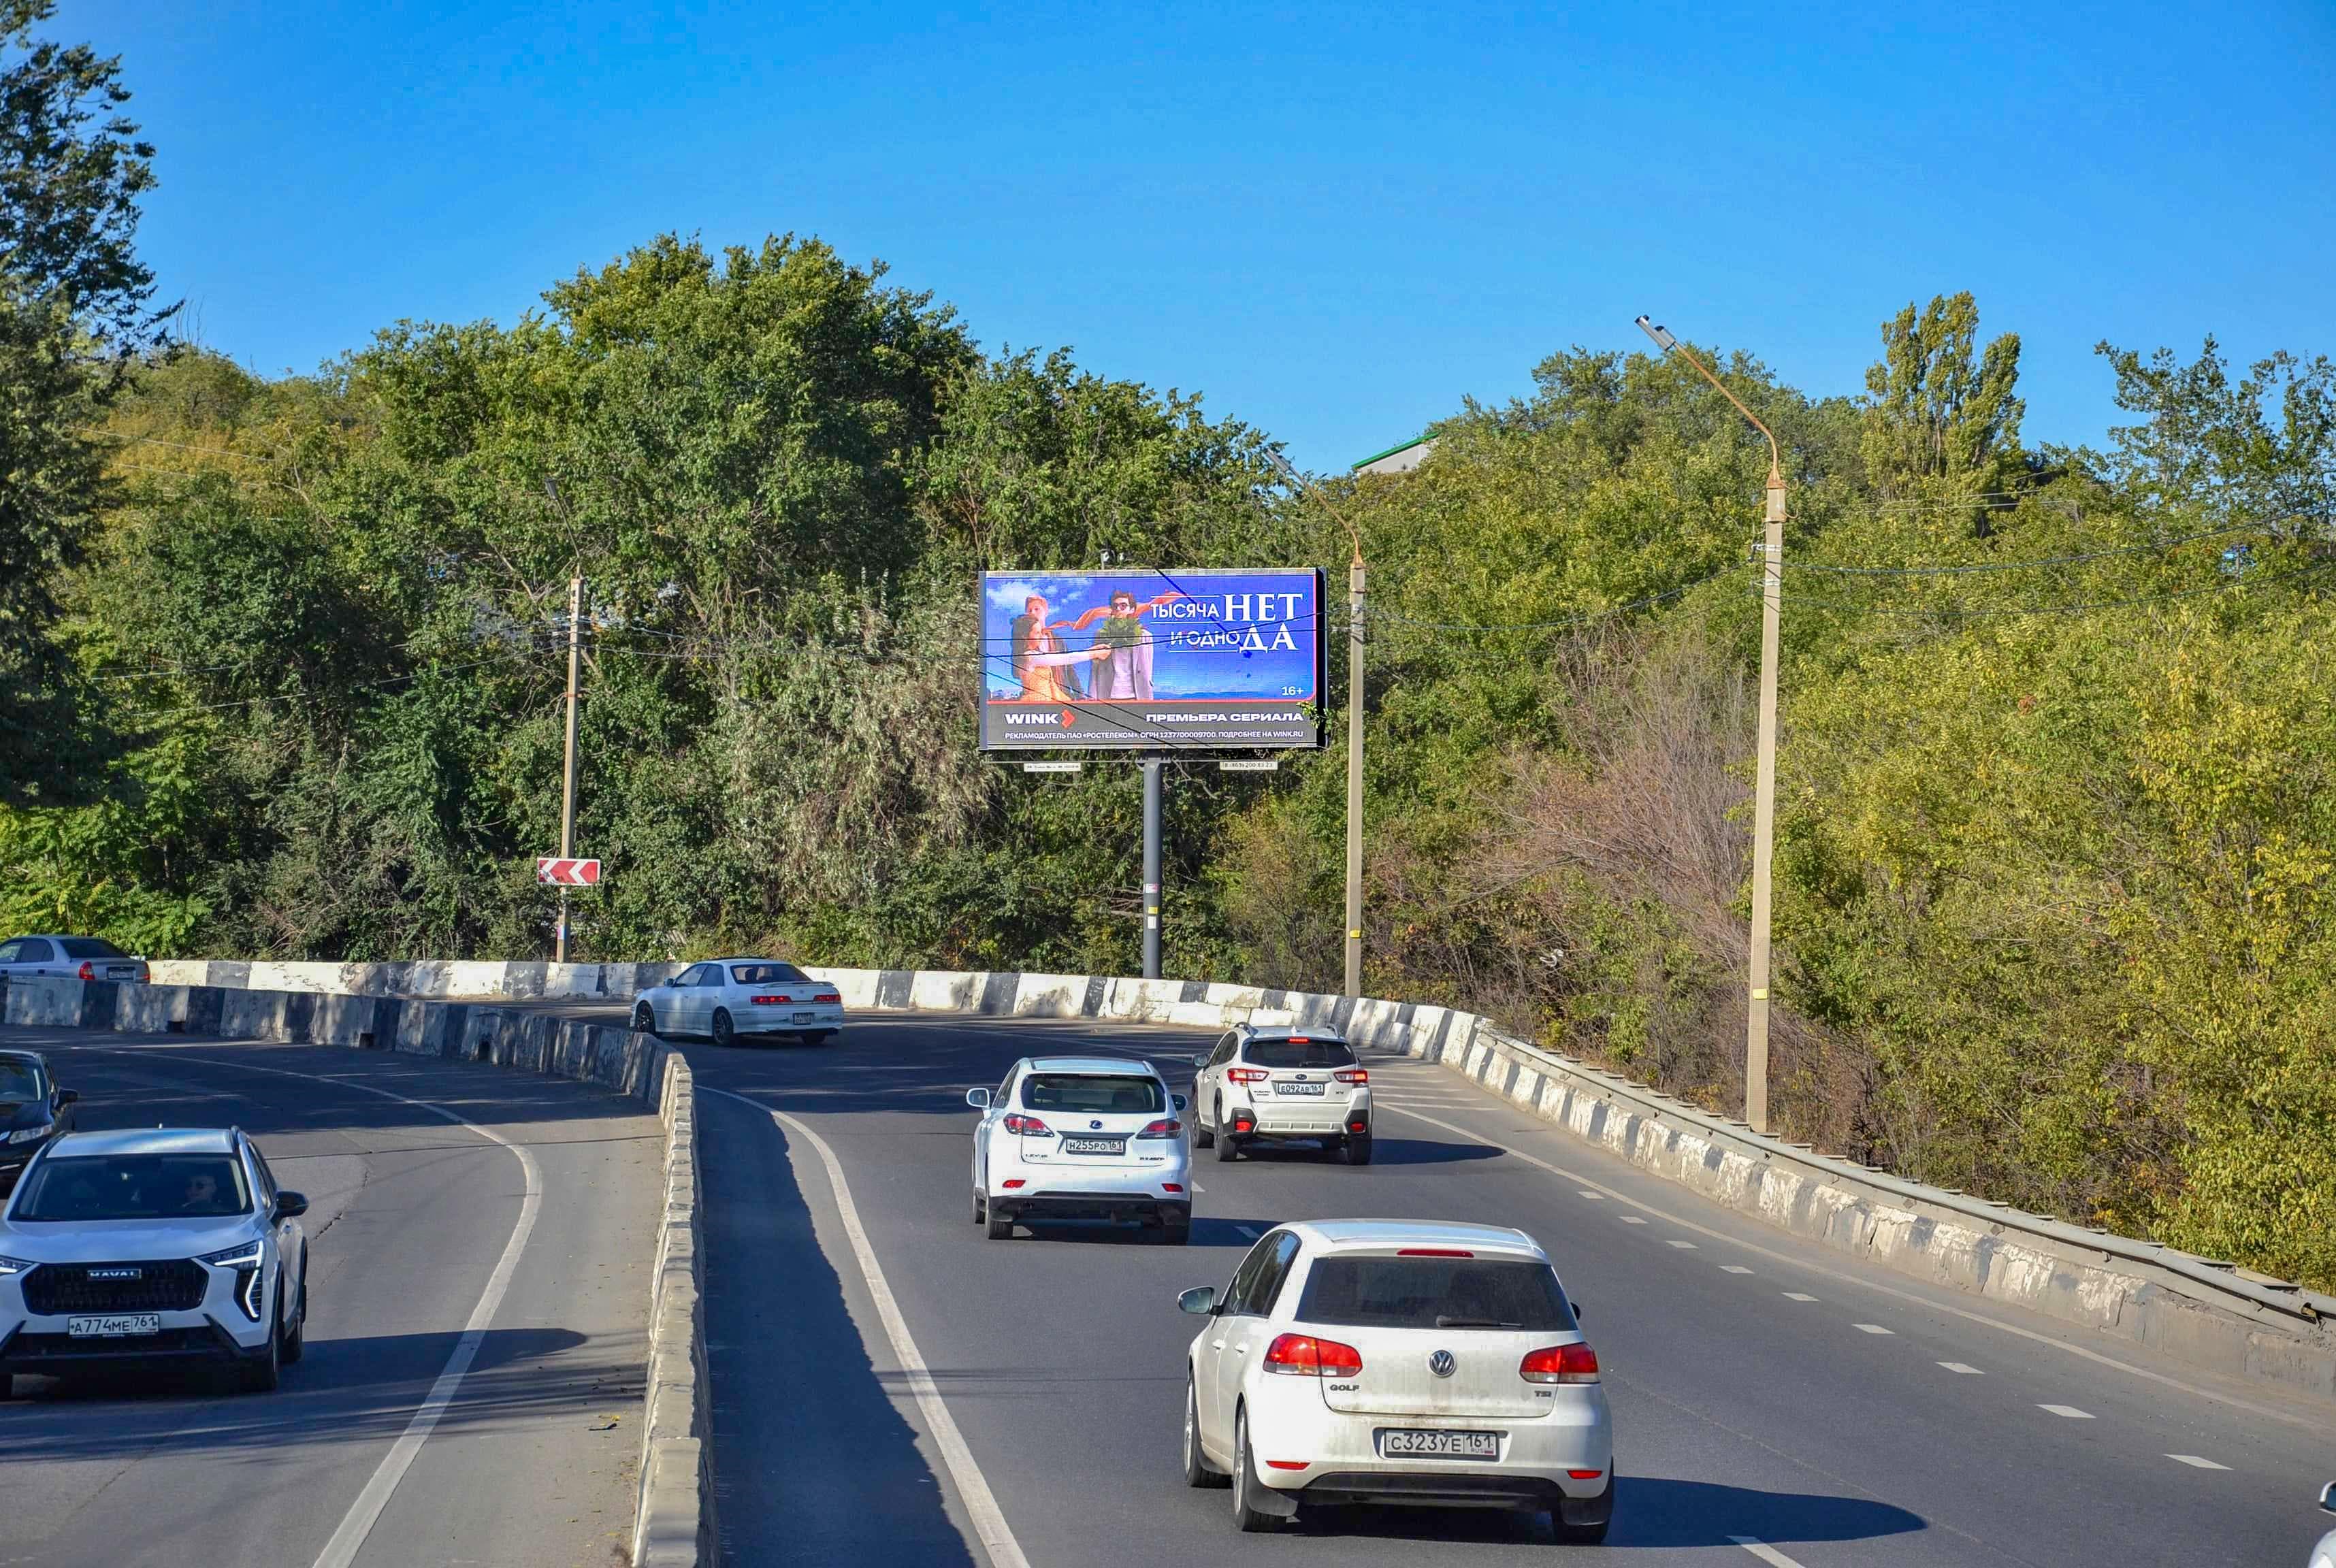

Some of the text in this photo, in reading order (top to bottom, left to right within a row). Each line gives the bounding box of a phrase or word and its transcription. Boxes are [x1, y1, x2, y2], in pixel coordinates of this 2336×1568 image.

[1151, 593, 1303, 622] ТЫСЯЧА НЕТ
[1170, 622, 1299, 654] И ОДНО ДА
[1282, 686, 1304, 696] 16+
[1005, 714, 1059, 724] WINK
[1146, 713, 1303, 723] ПРЕМЬЕРА СЕРИАЛА
[1069, 1140, 1106, 1150] Н255РО
[75, 1316, 155, 1333] А774МЕ 761
[1329, 1384, 1360, 1392] GOLF
[1391, 1433, 1491, 1452] С323УЕ 161
